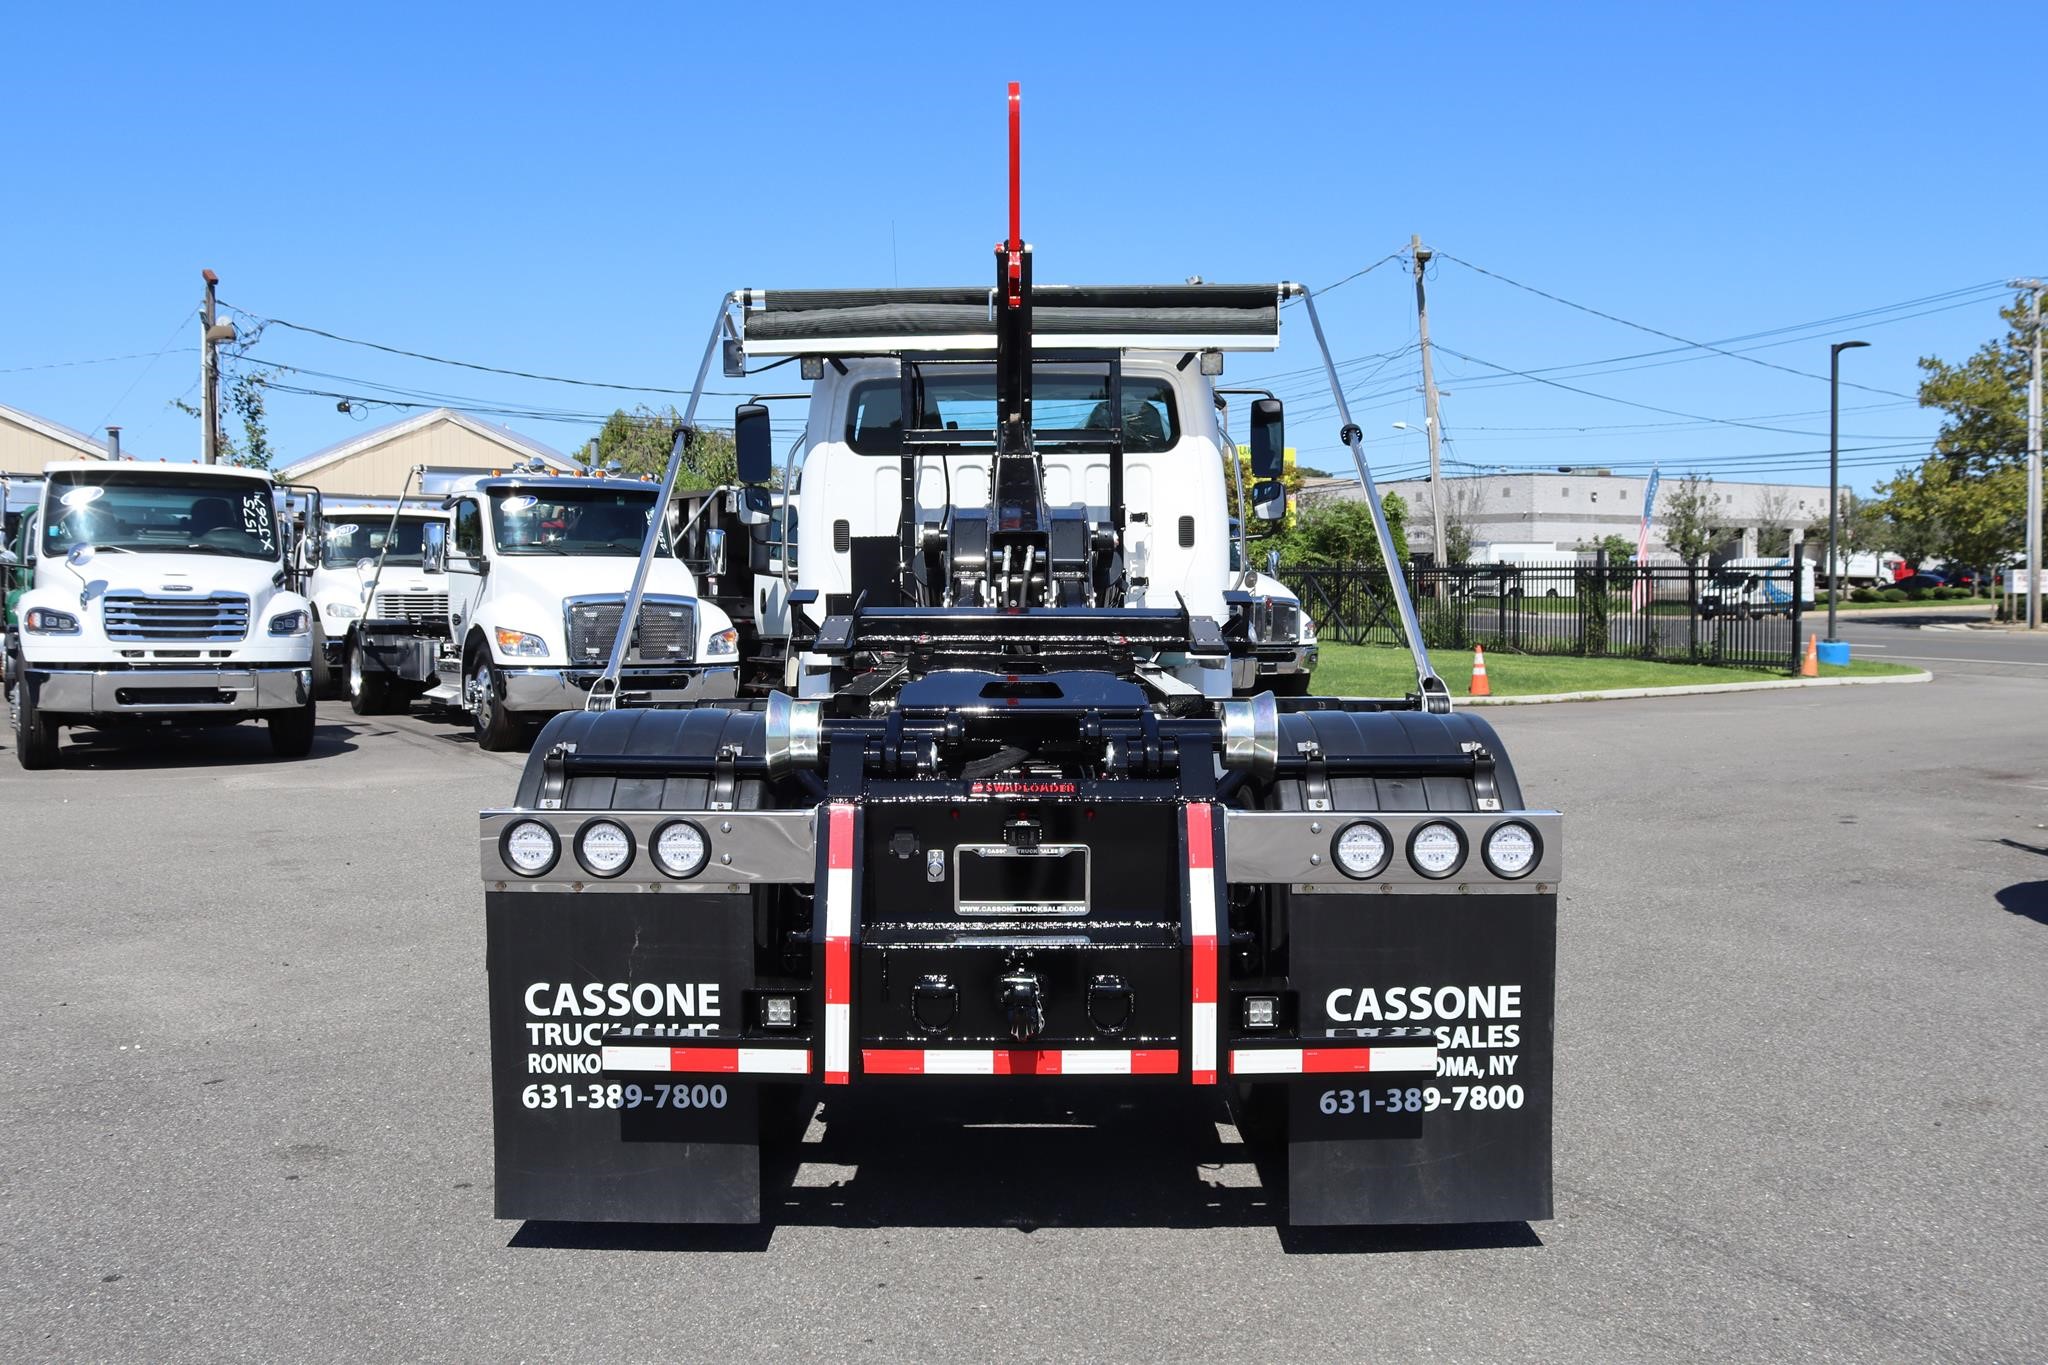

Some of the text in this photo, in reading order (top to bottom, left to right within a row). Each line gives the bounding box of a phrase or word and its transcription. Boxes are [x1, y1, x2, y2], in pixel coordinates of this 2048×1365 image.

[243, 496, 257, 532] 1575
[986, 782, 1075, 793] SWAPLOADER
[1017, 848, 1038, 857] TRUCK
[1039, 848, 1059, 857] SALES
[524, 983, 721, 1017] CASSONE
[1325, 985, 1522, 1022] CASSONE
[1434, 1025, 1520, 1050] SALES
[1489, 1055, 1519, 1076] NY
[522, 1083, 728, 1109] 631-389-7800
[1319, 1084, 1525, 1115] 631-389-7800
